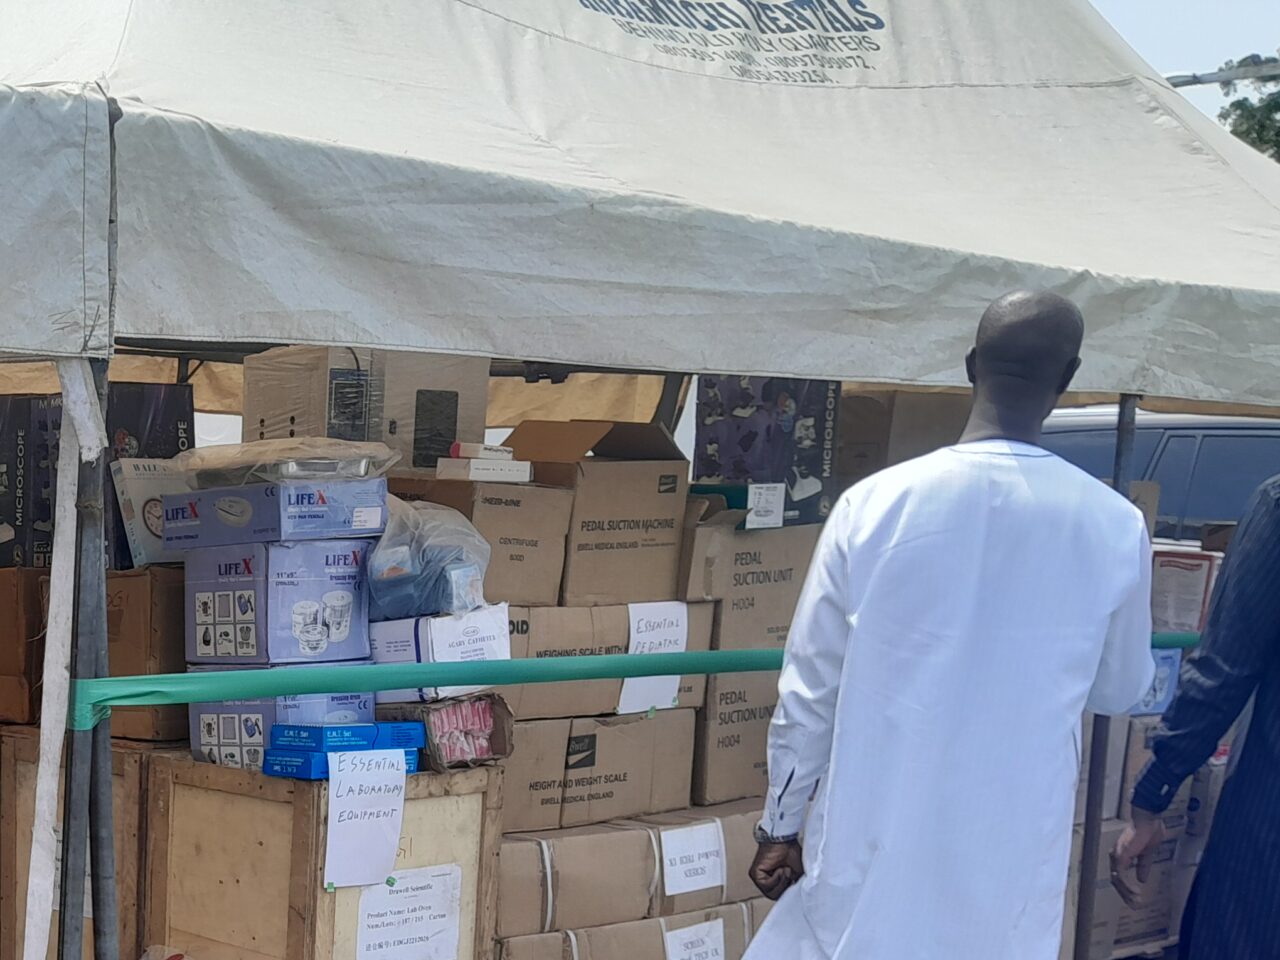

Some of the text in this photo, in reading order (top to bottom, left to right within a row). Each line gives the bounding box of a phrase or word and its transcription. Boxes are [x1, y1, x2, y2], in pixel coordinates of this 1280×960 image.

[612, 18, 881, 52] BEHIND OLD POLY QUARTERS
[822, 381, 837, 478] MICROSCOPE
[15, 428, 25, 526] MICROSCOPE
[288, 489, 328, 506] LIFEX
[165, 500, 200, 521] LIFEX
[581, 518, 675, 531] PEDAL SUCTION MACHINE
[499, 537, 538, 547] CENTRIFUGE
[218, 558, 253, 576] LIFEX
[325, 550, 361, 567] LIFEX
[734, 552, 762, 566] PEDAL
[732, 568, 794, 587] SUCTION UNIT
[732, 596, 755, 611] H004
[636, 617, 681, 634] ESSENTIAL
[578, 646, 603, 657] SCALE
[719, 690, 748, 706] PEDAL
[718, 709, 758, 726] SUCTION
[717, 734, 741, 750] H004
[337, 753, 403, 773] ESSENTIAL
[529, 772, 628, 791] HEIGHT AND WEIGHT SCALE
[587, 791, 614, 801] ENGLAND
[337, 808, 399, 824] EQUIPMENT
[410, 883, 433, 892] Scientific
[367, 910, 388, 919] Product
